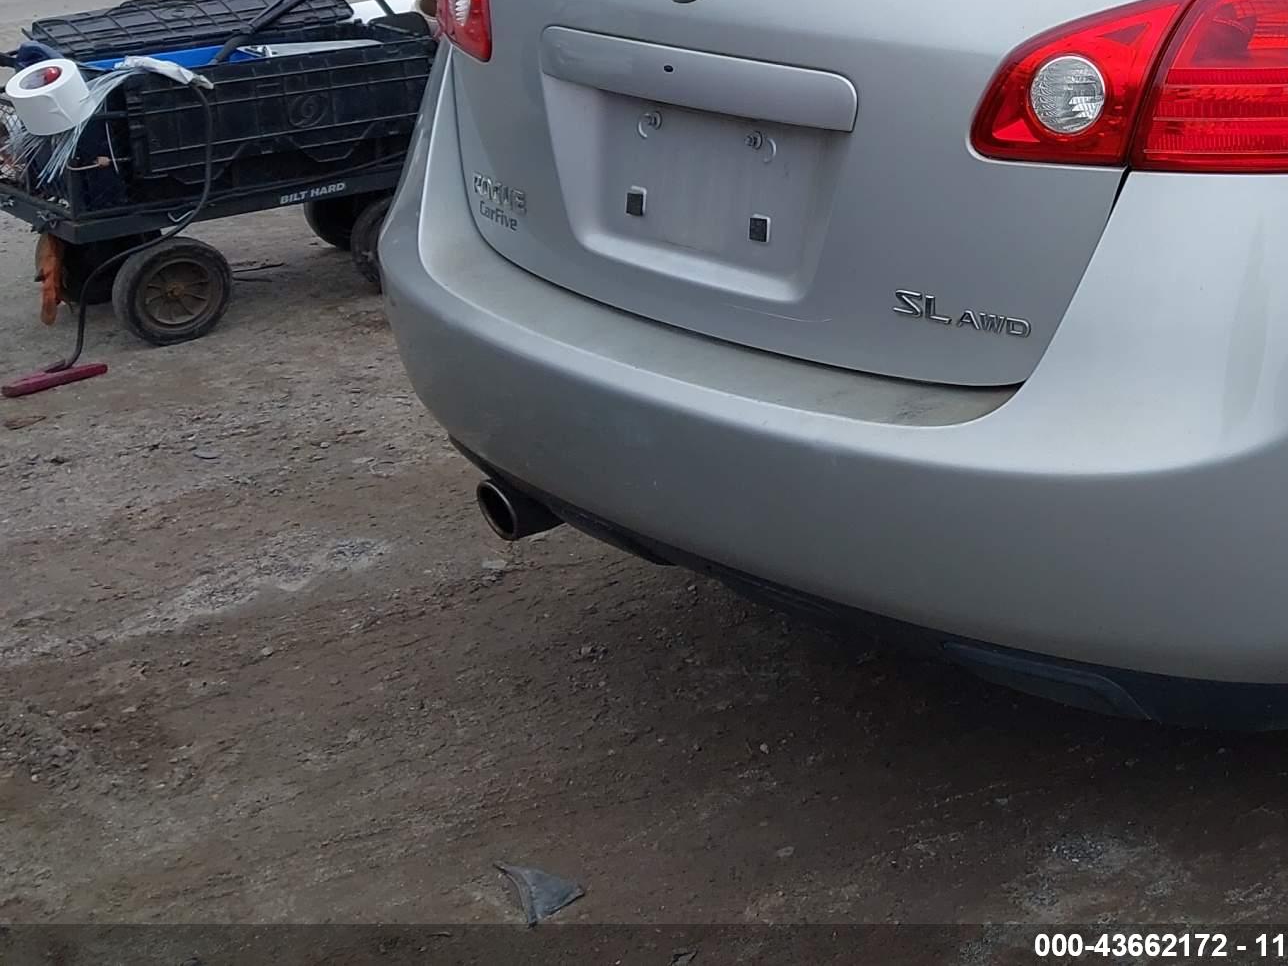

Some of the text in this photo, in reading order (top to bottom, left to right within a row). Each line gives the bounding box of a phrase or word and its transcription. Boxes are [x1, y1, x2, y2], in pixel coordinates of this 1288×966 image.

[280, 182, 345, 204] BILT HARD
[893, 289, 1032, 339] SL AWD
